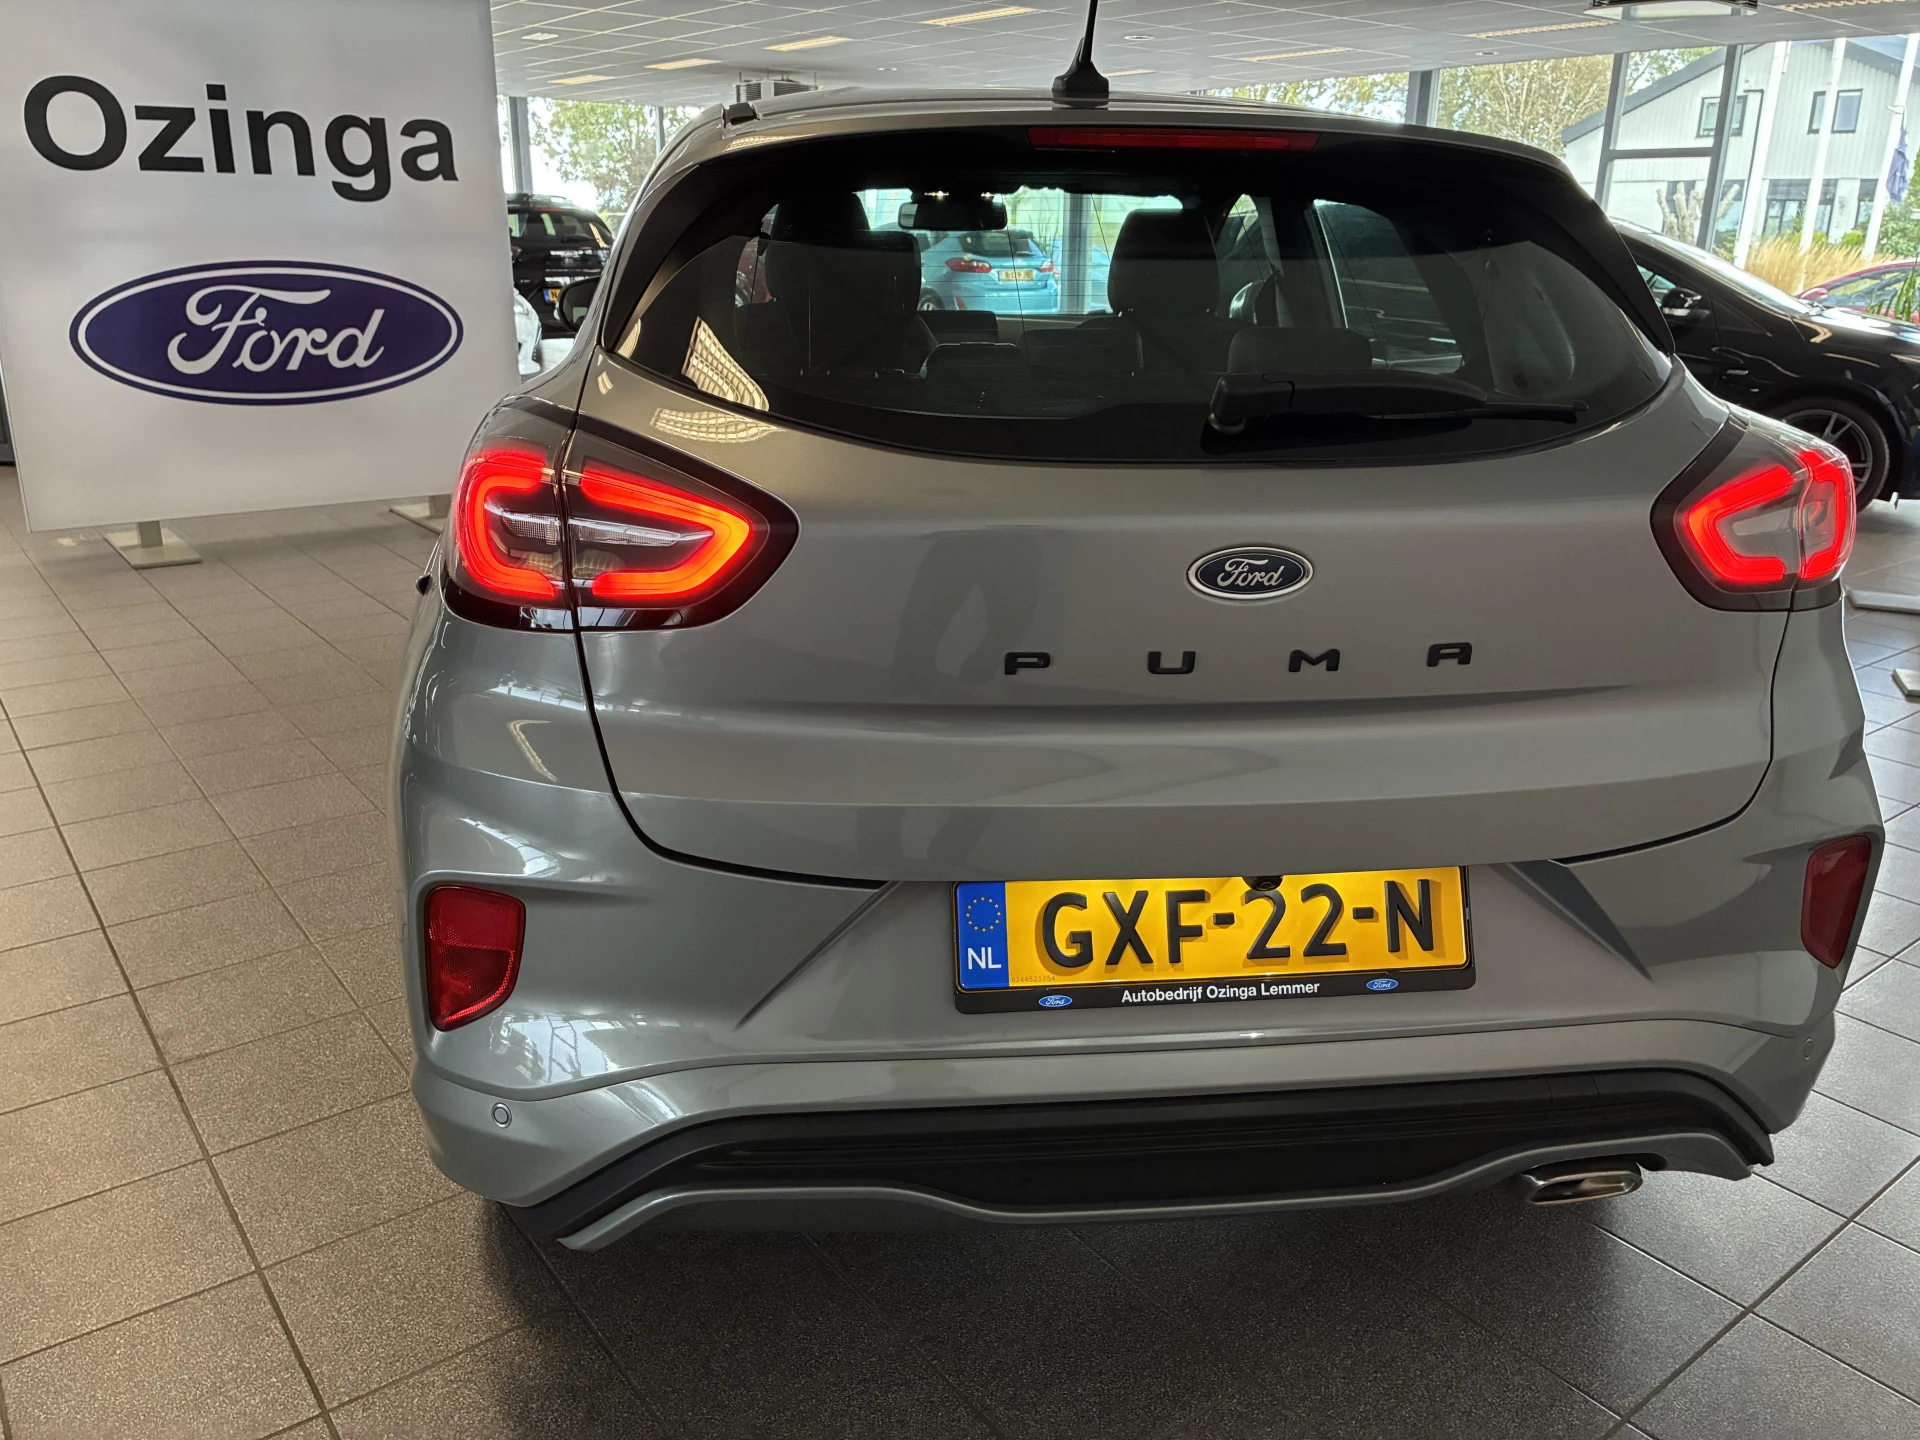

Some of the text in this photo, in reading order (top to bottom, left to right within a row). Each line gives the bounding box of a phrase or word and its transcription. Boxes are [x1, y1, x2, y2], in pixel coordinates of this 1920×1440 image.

[24, 75, 458, 202] Ozinga
[167, 285, 384, 374] Ford
[1216, 558, 1285, 587] Ford
[1004, 642, 1472, 675] PUMA
[1042, 879, 1435, 968] GXF-22-N
[967, 946, 1002, 970] NL
[1121, 982, 1320, 1003] Autobedrijf Ozinga Lemmer
